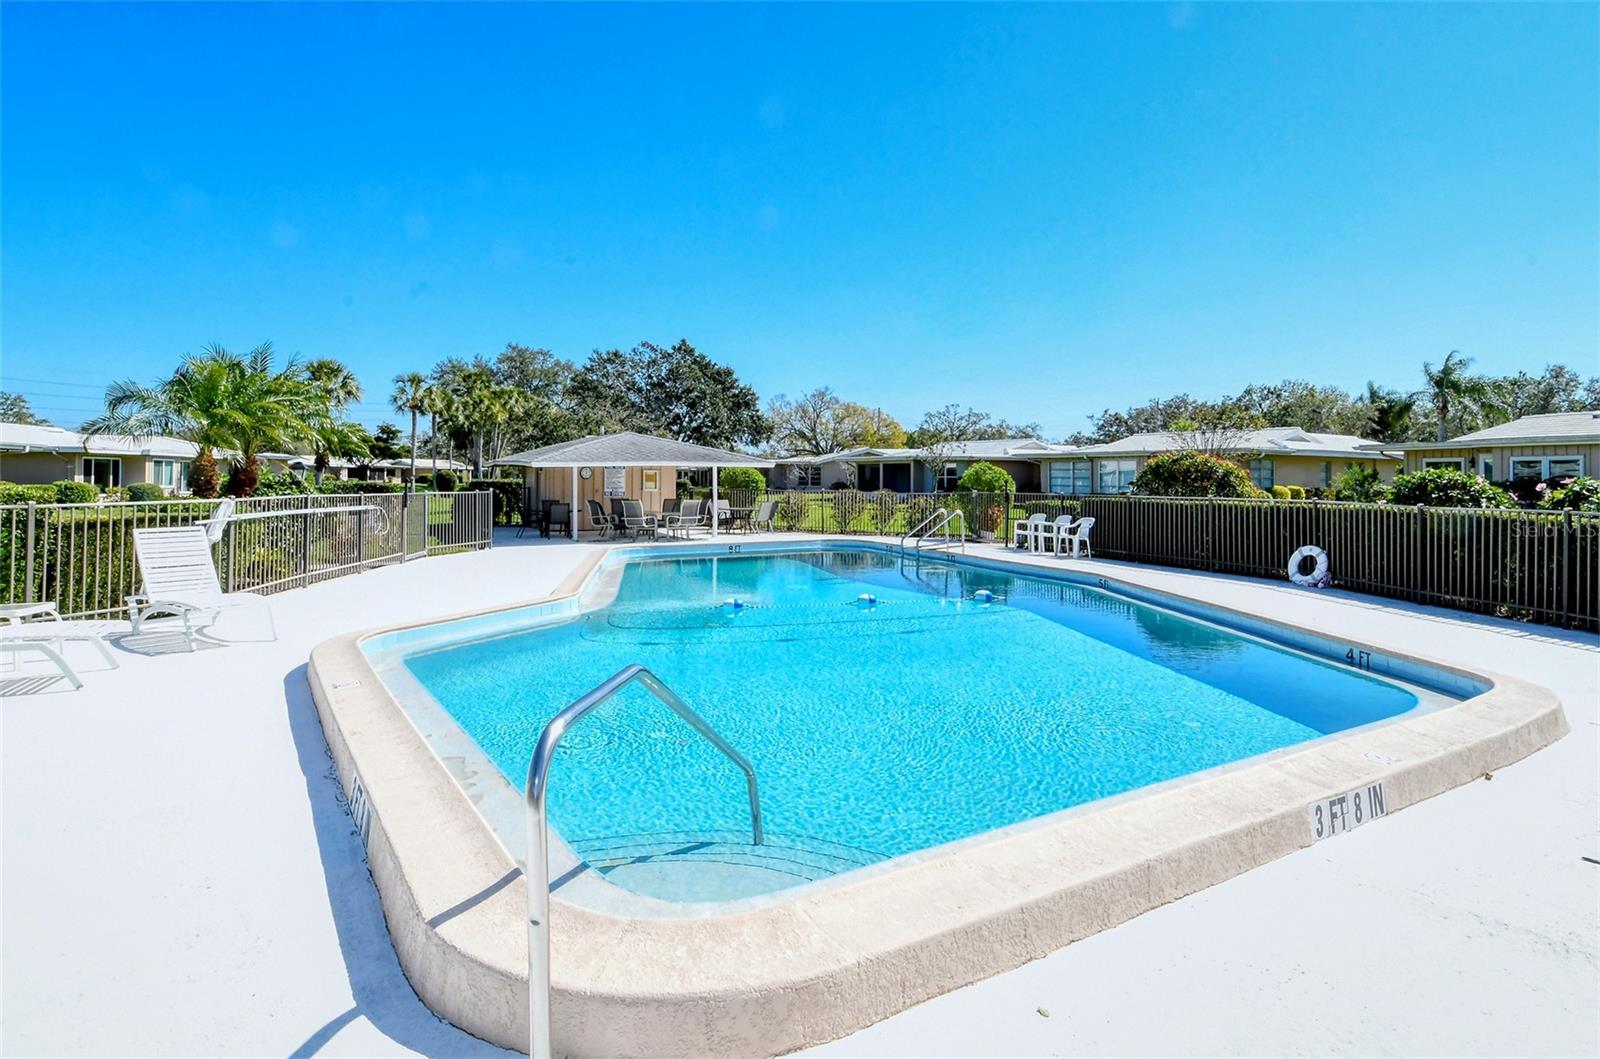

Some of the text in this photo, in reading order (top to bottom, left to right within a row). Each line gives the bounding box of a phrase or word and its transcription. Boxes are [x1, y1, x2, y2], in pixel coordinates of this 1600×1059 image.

[1346, 647, 1371, 672] 4 FT
[1315, 783, 1385, 838] 3 FT 8 IN
